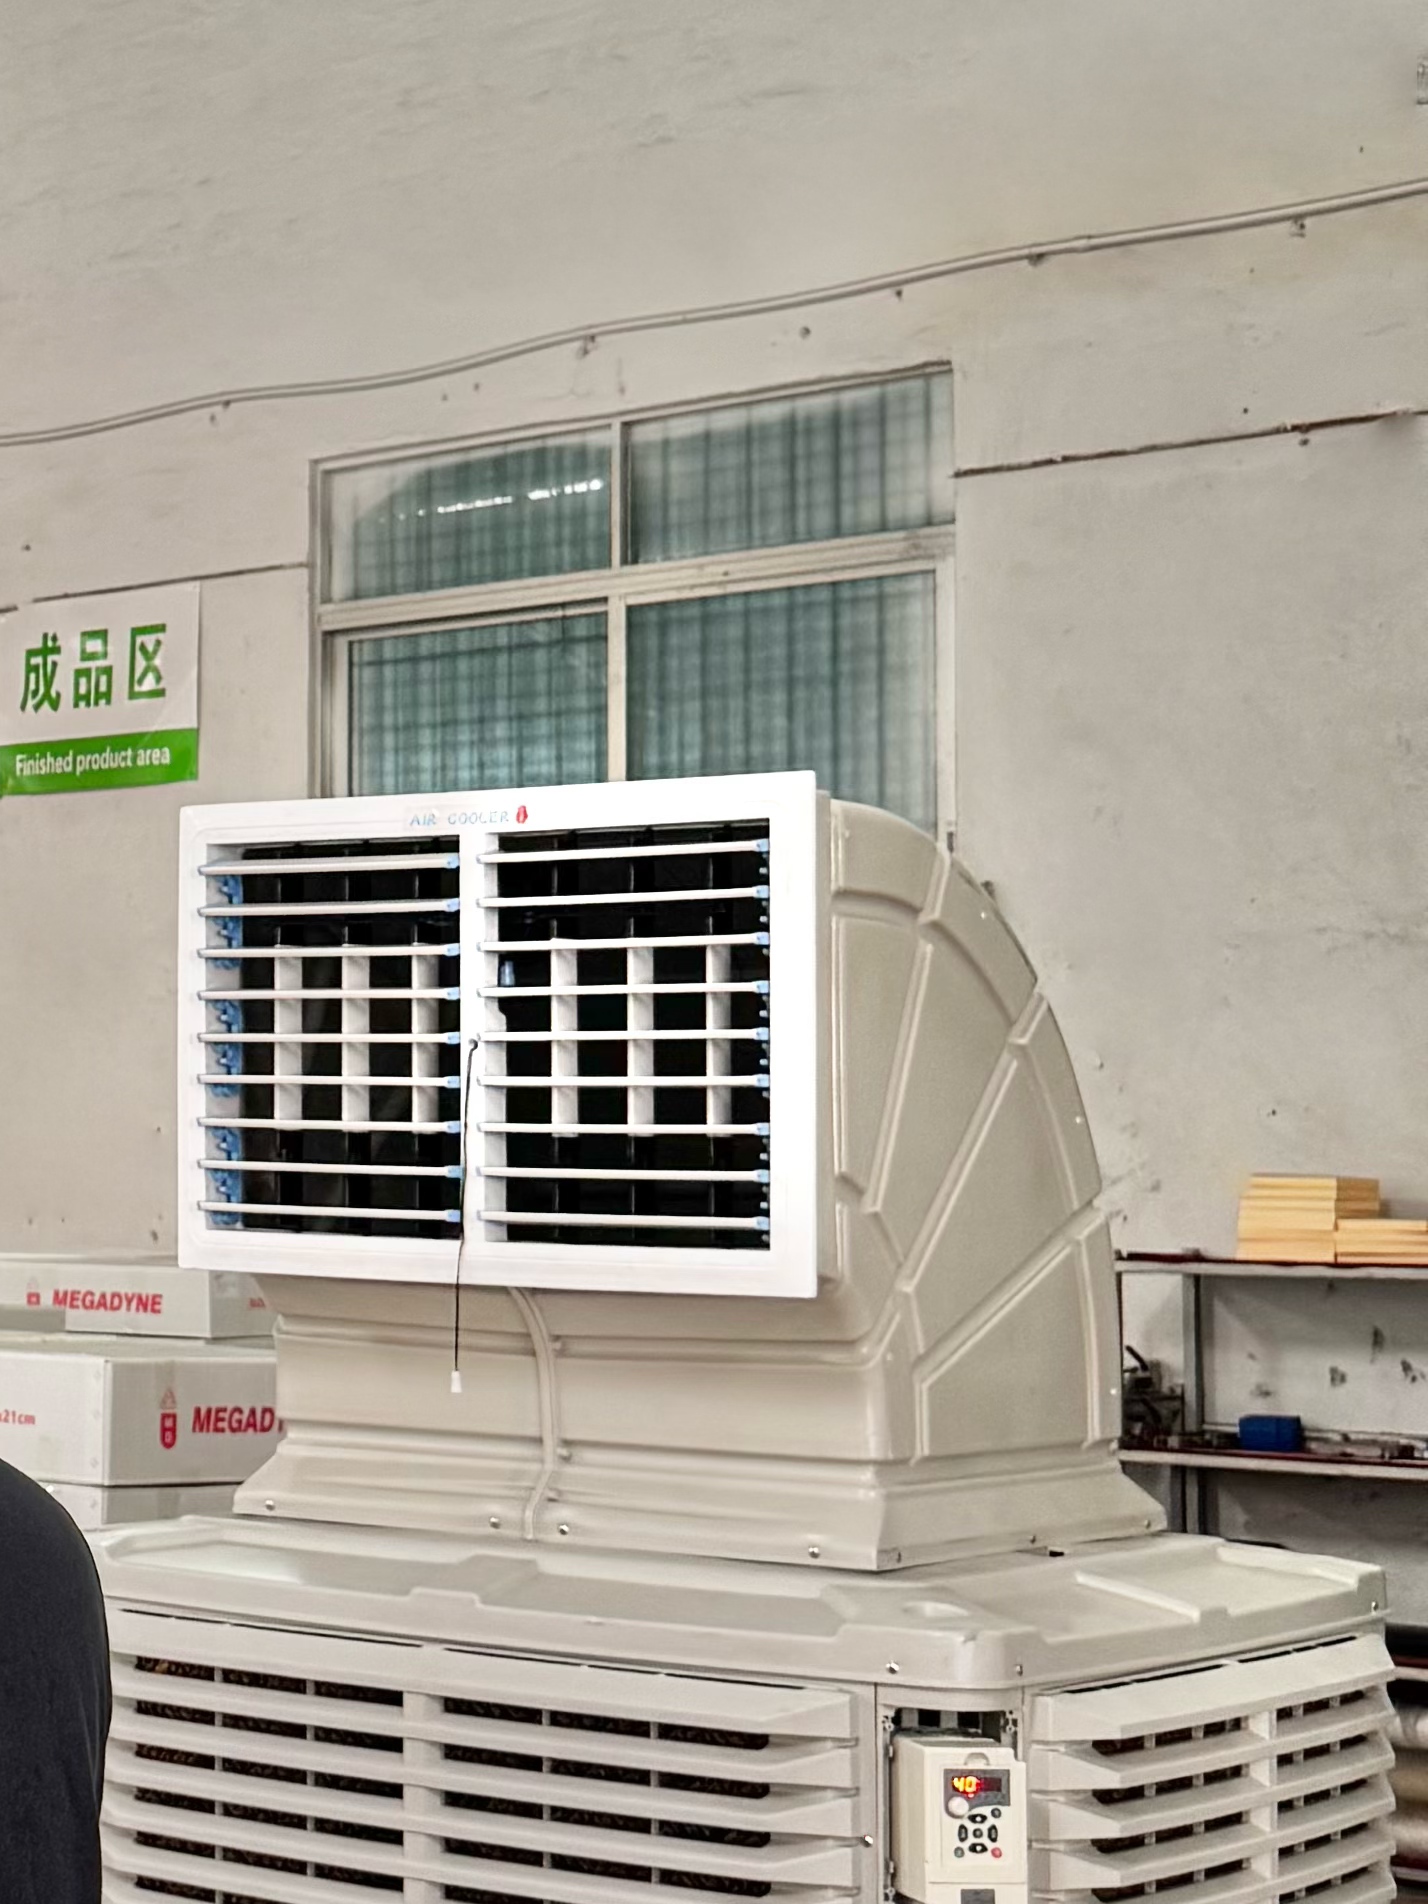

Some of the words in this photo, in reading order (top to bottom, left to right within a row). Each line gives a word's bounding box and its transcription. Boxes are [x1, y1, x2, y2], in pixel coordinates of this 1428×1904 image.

[20, 623, 166, 713] 成品区
[16, 750, 74, 777] Finished
[76, 747, 133, 775] product
[136, 746, 171, 765] area
[409, 813, 437, 827] AIR
[447, 809, 510, 825] COOLER
[52, 1288, 163, 1315] MEGADYNE
